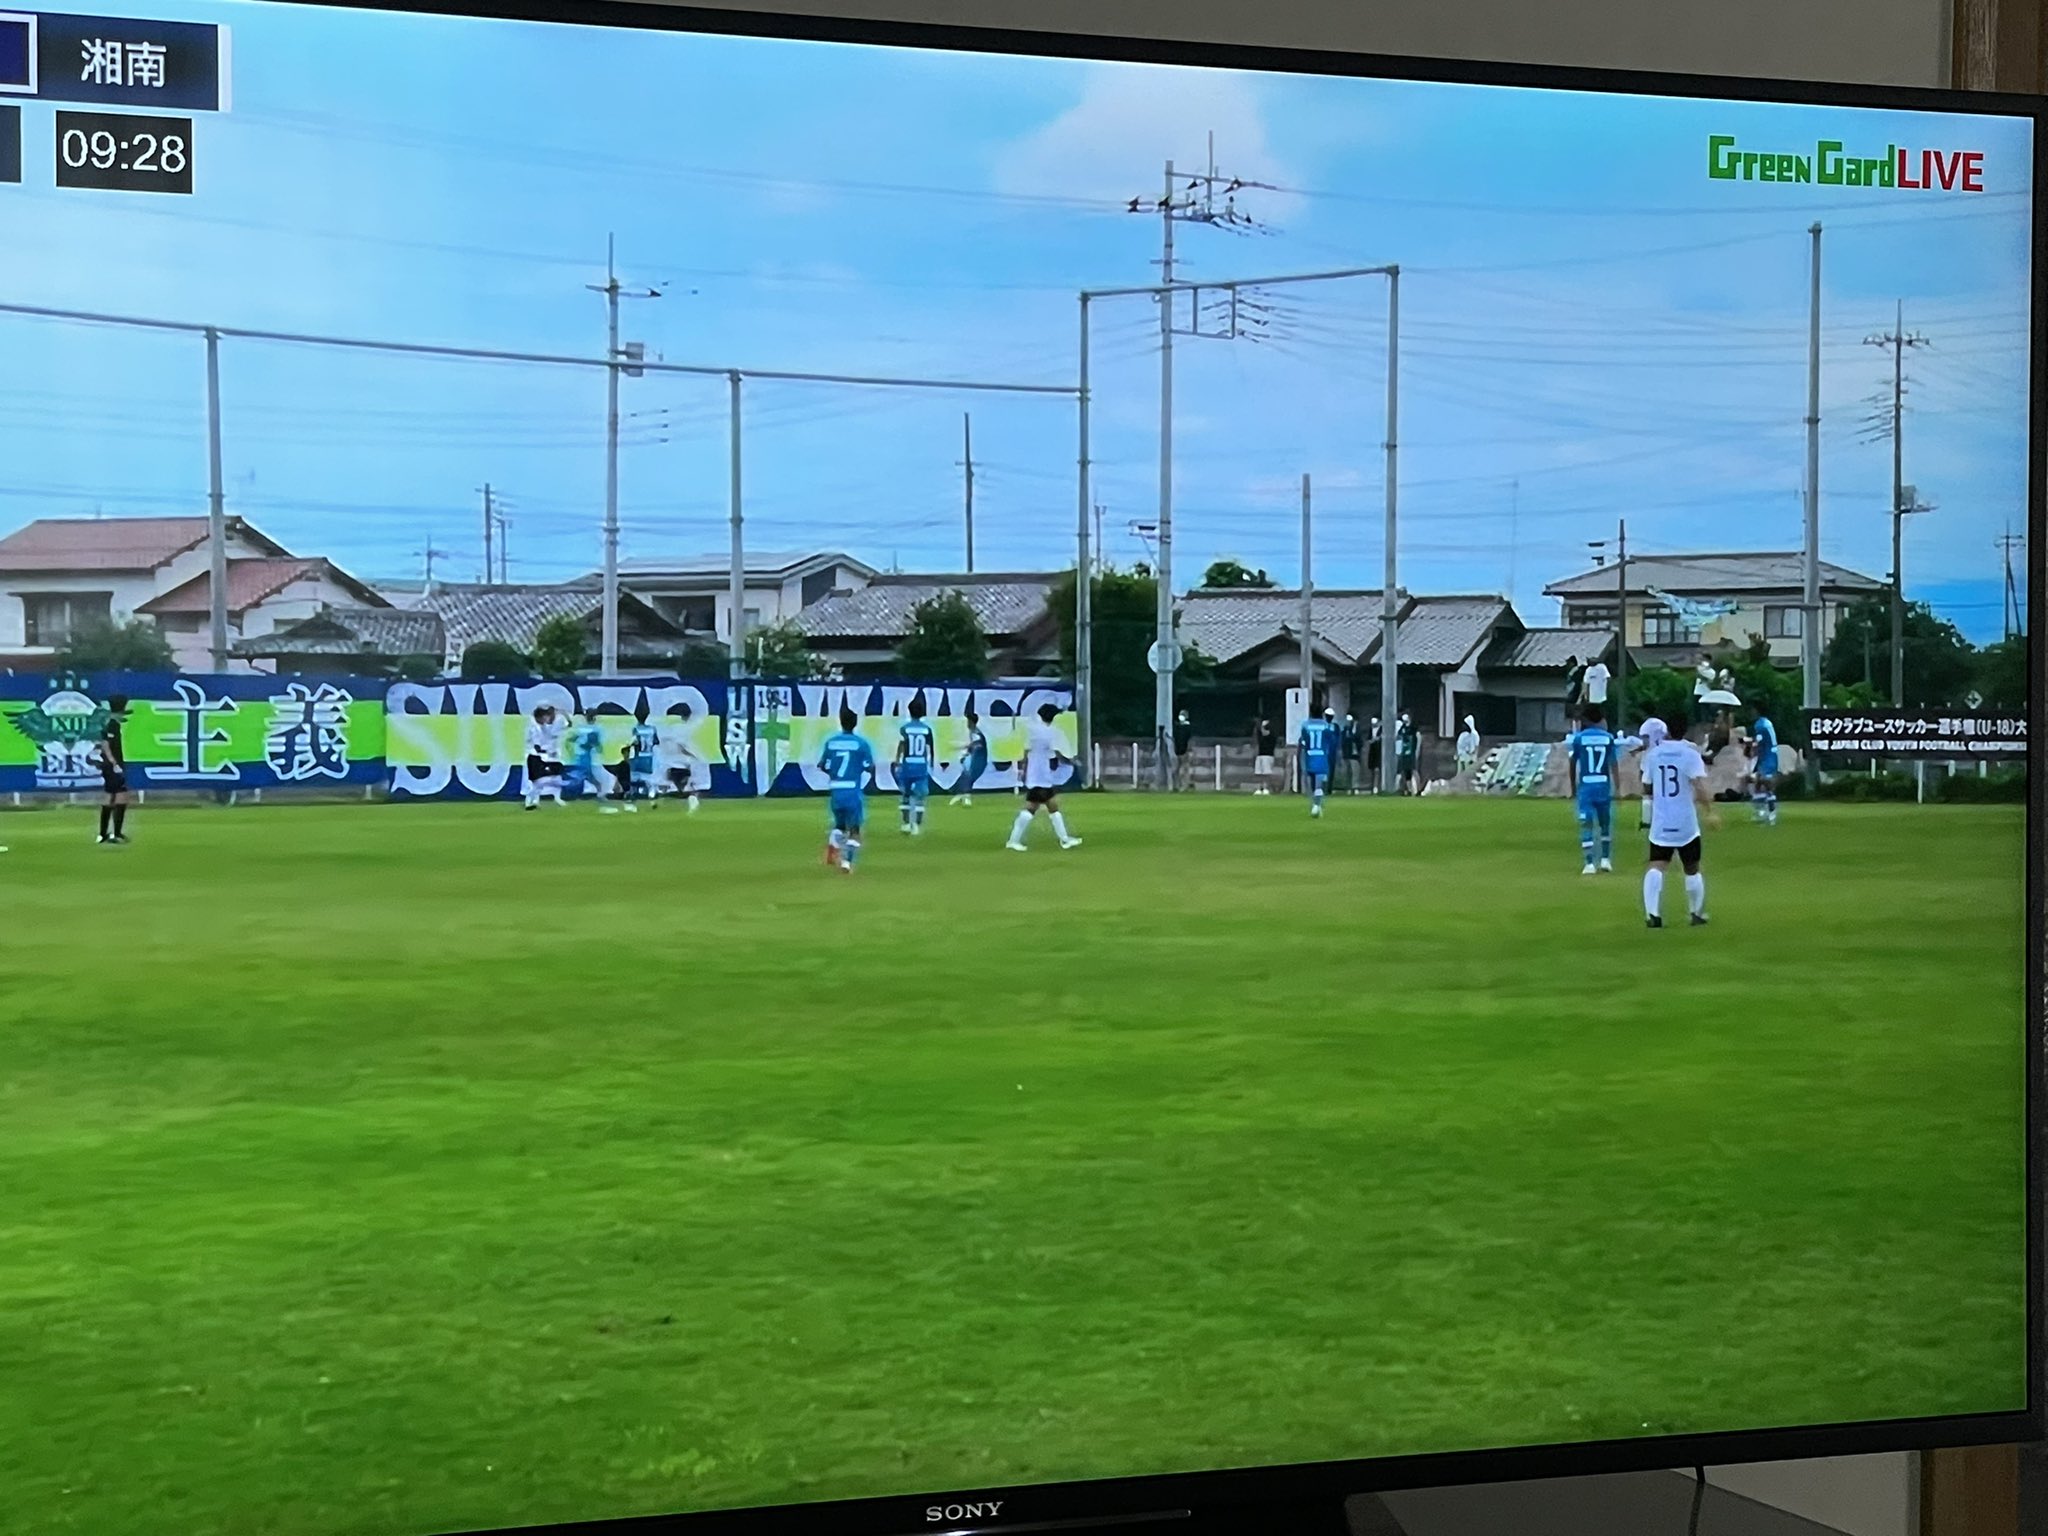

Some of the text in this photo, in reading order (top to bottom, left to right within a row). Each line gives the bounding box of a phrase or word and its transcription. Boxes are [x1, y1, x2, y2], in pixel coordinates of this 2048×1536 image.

[80, 38, 167, 88] 湘南
[62, 129, 186, 173] 09:28
[909, 735, 926, 757] 10
[1586, 746, 1607, 774] 17
[836, 752, 850, 777] 7
[1658, 765, 1680, 798] 13
[926, 1501, 1003, 1521] SONY
